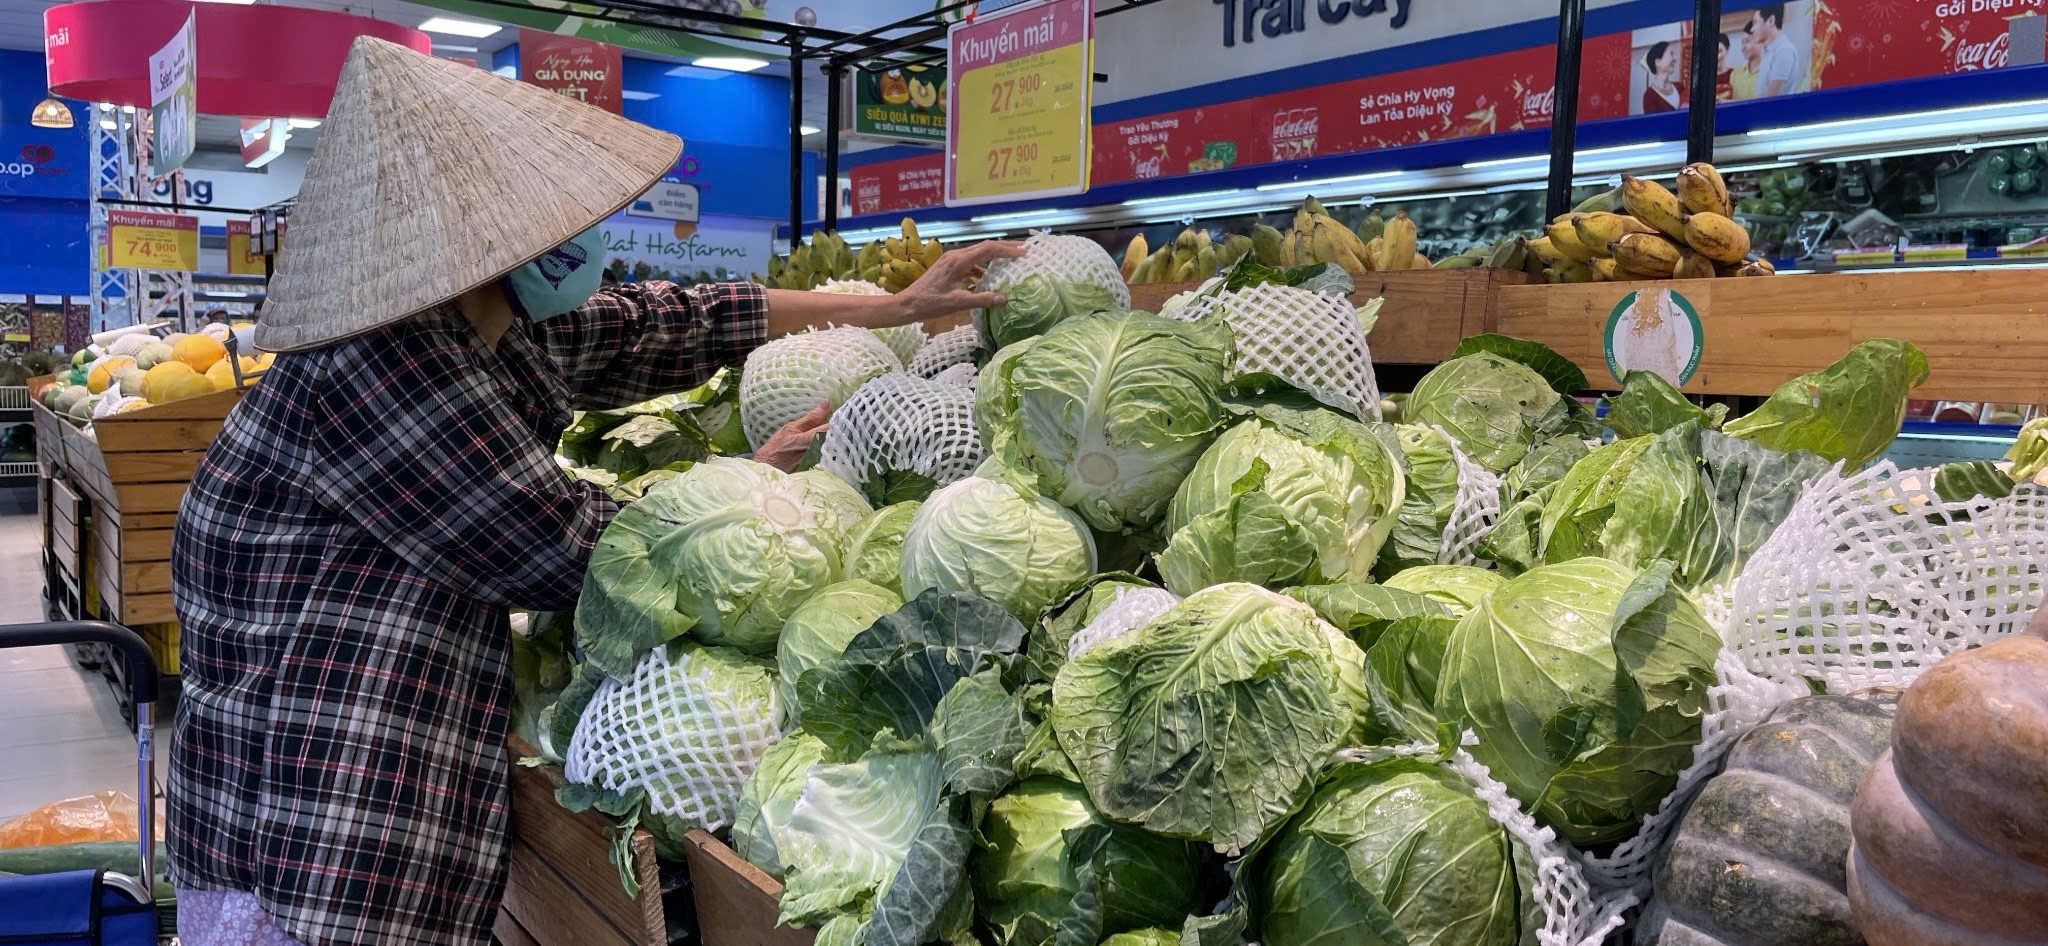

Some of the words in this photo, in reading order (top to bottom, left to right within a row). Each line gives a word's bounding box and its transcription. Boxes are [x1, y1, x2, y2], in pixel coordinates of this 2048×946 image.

[960, 22, 1018, 64] Khuyến
[1024, 14, 1054, 47] mãi
[535, 69, 560, 80] GIA
[563, 69, 606, 84] DỤNG
[1377, 93, 1402, 107] Chia
[1404, 88, 1420, 103] Hy
[1423, 84, 1456, 101] Vọng
[1360, 111, 1381, 125] Lan
[1407, 100, 1433, 120] Diệu
